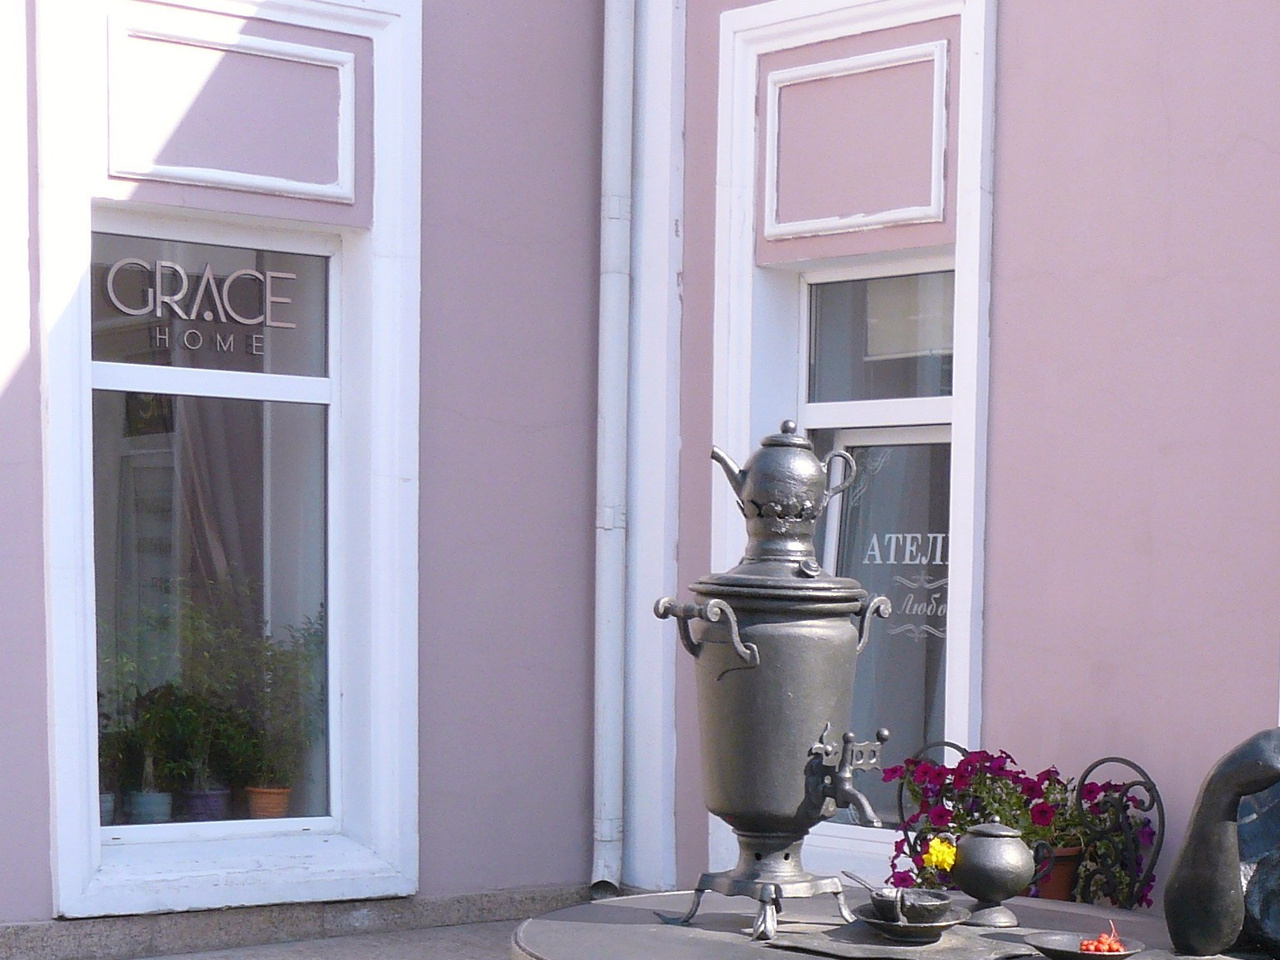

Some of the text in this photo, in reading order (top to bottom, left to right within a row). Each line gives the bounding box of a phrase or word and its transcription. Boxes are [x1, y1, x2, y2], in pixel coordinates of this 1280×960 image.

[107, 257, 297, 328] GRACE
[156, 326, 265, 355] HOME
[862, 533, 950, 565] АТЕЛ
